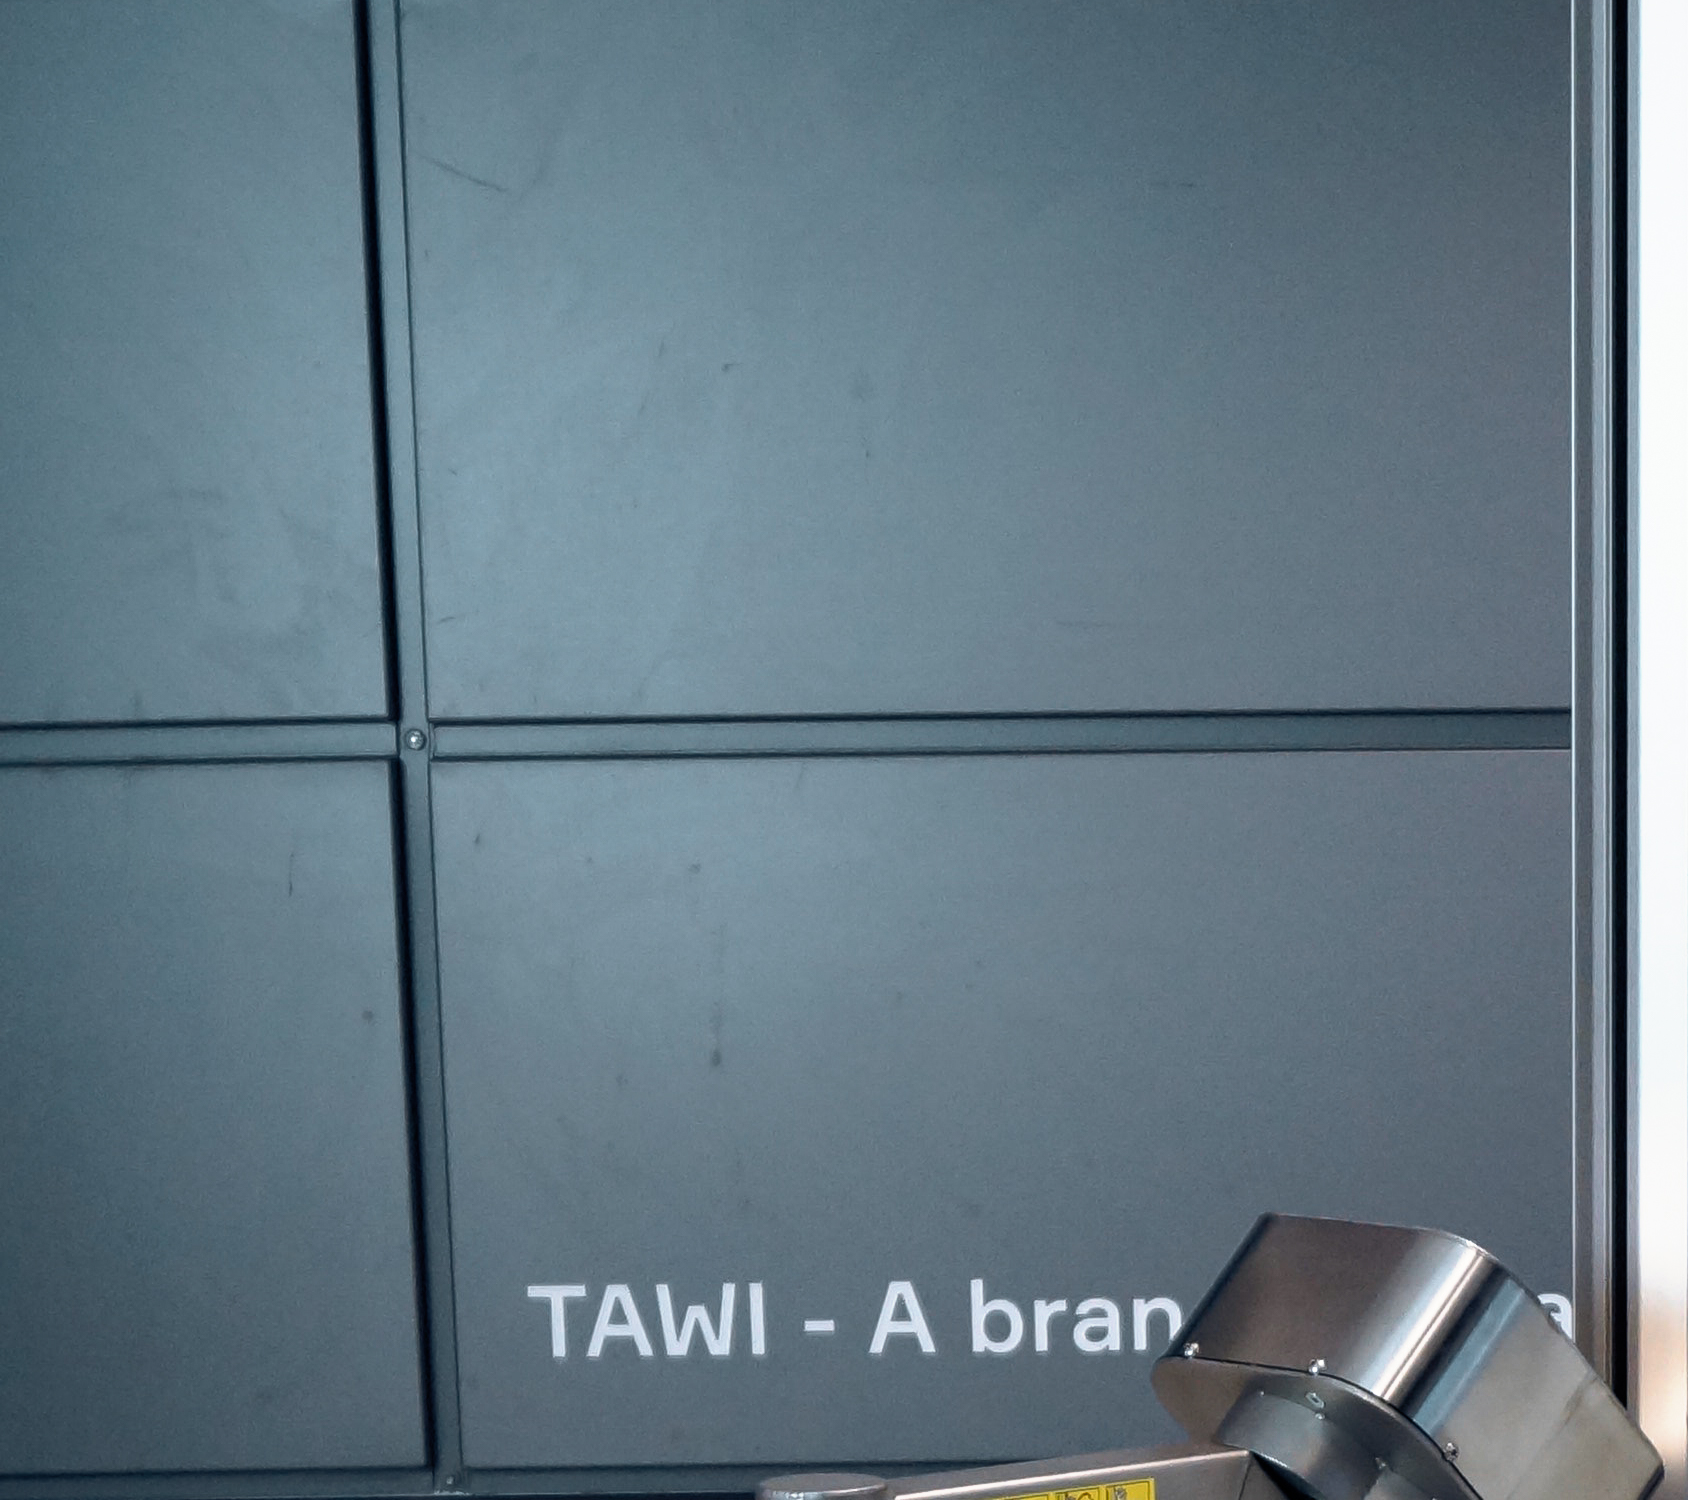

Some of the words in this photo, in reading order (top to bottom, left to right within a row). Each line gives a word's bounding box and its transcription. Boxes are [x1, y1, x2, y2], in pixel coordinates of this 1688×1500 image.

[527, 1282, 764, 1357] TAWI
[804, 1319, 834, 1333] -
[869, 1280, 936, 1354] A
[970, 1279, 1184, 1353] bran
